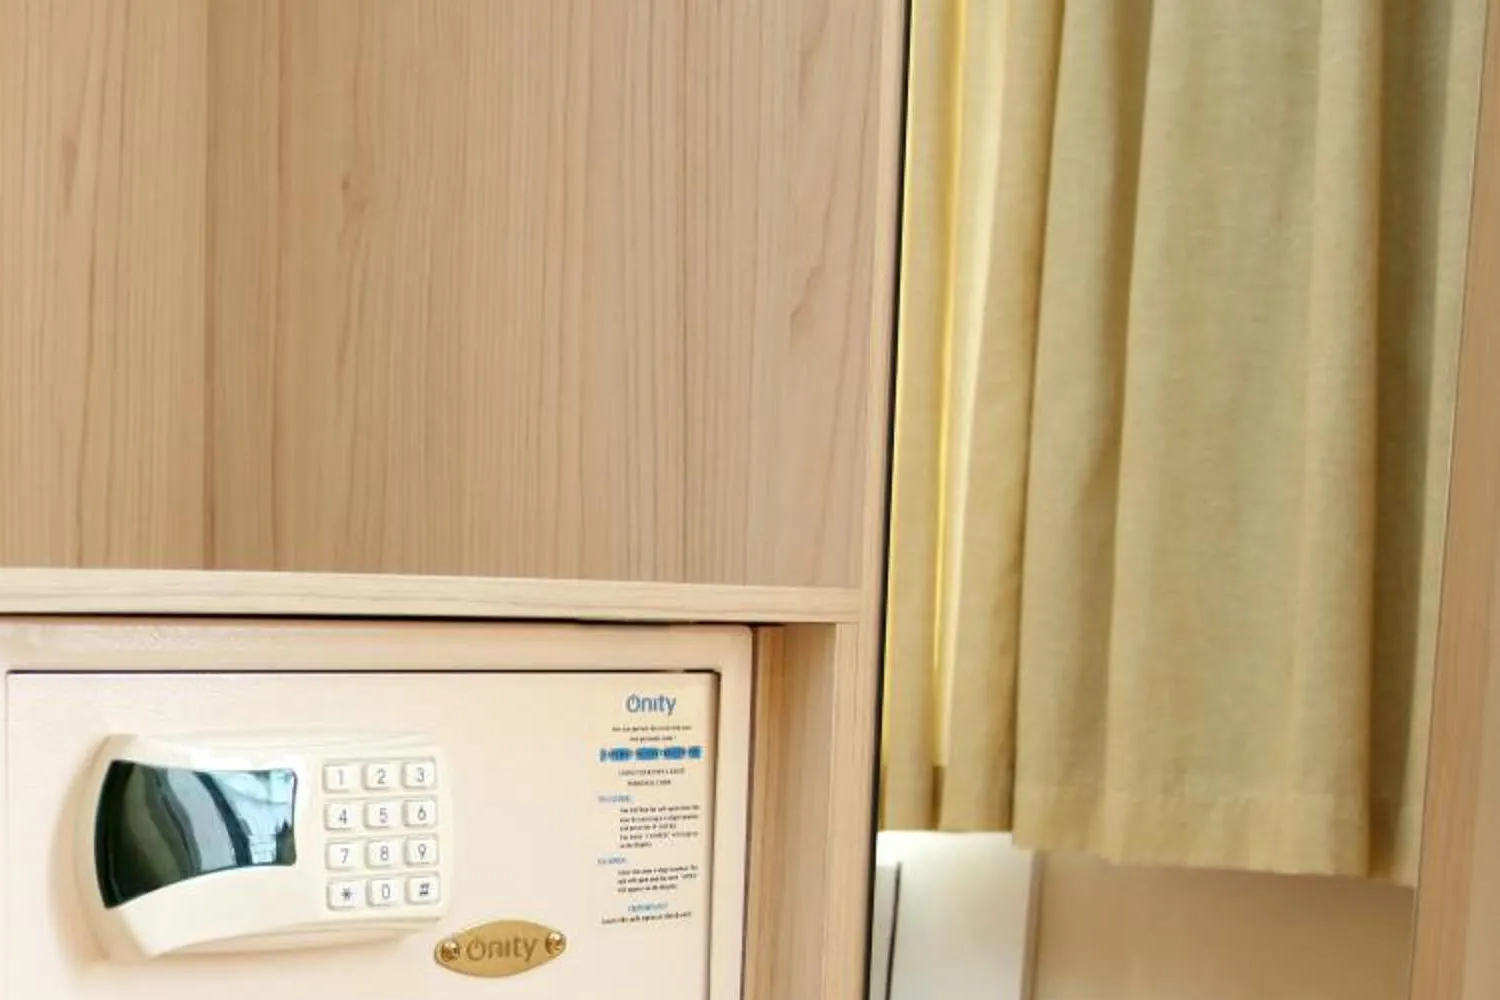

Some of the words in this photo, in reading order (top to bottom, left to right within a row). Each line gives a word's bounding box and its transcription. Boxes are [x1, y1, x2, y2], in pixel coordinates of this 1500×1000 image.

[625, 693, 677, 716] Onity
[376, 768, 387, 785] 2
[415, 767, 425, 783] 3
[338, 808, 348, 825] 4
[379, 807, 388, 825] 5
[417, 806, 427, 821] 6
[339, 847, 349, 864] 7
[380, 845, 389, 862] 8
[417, 843, 427, 860] 9
[381, 883, 391, 900] 0
[466, 935, 538, 962] Onity
